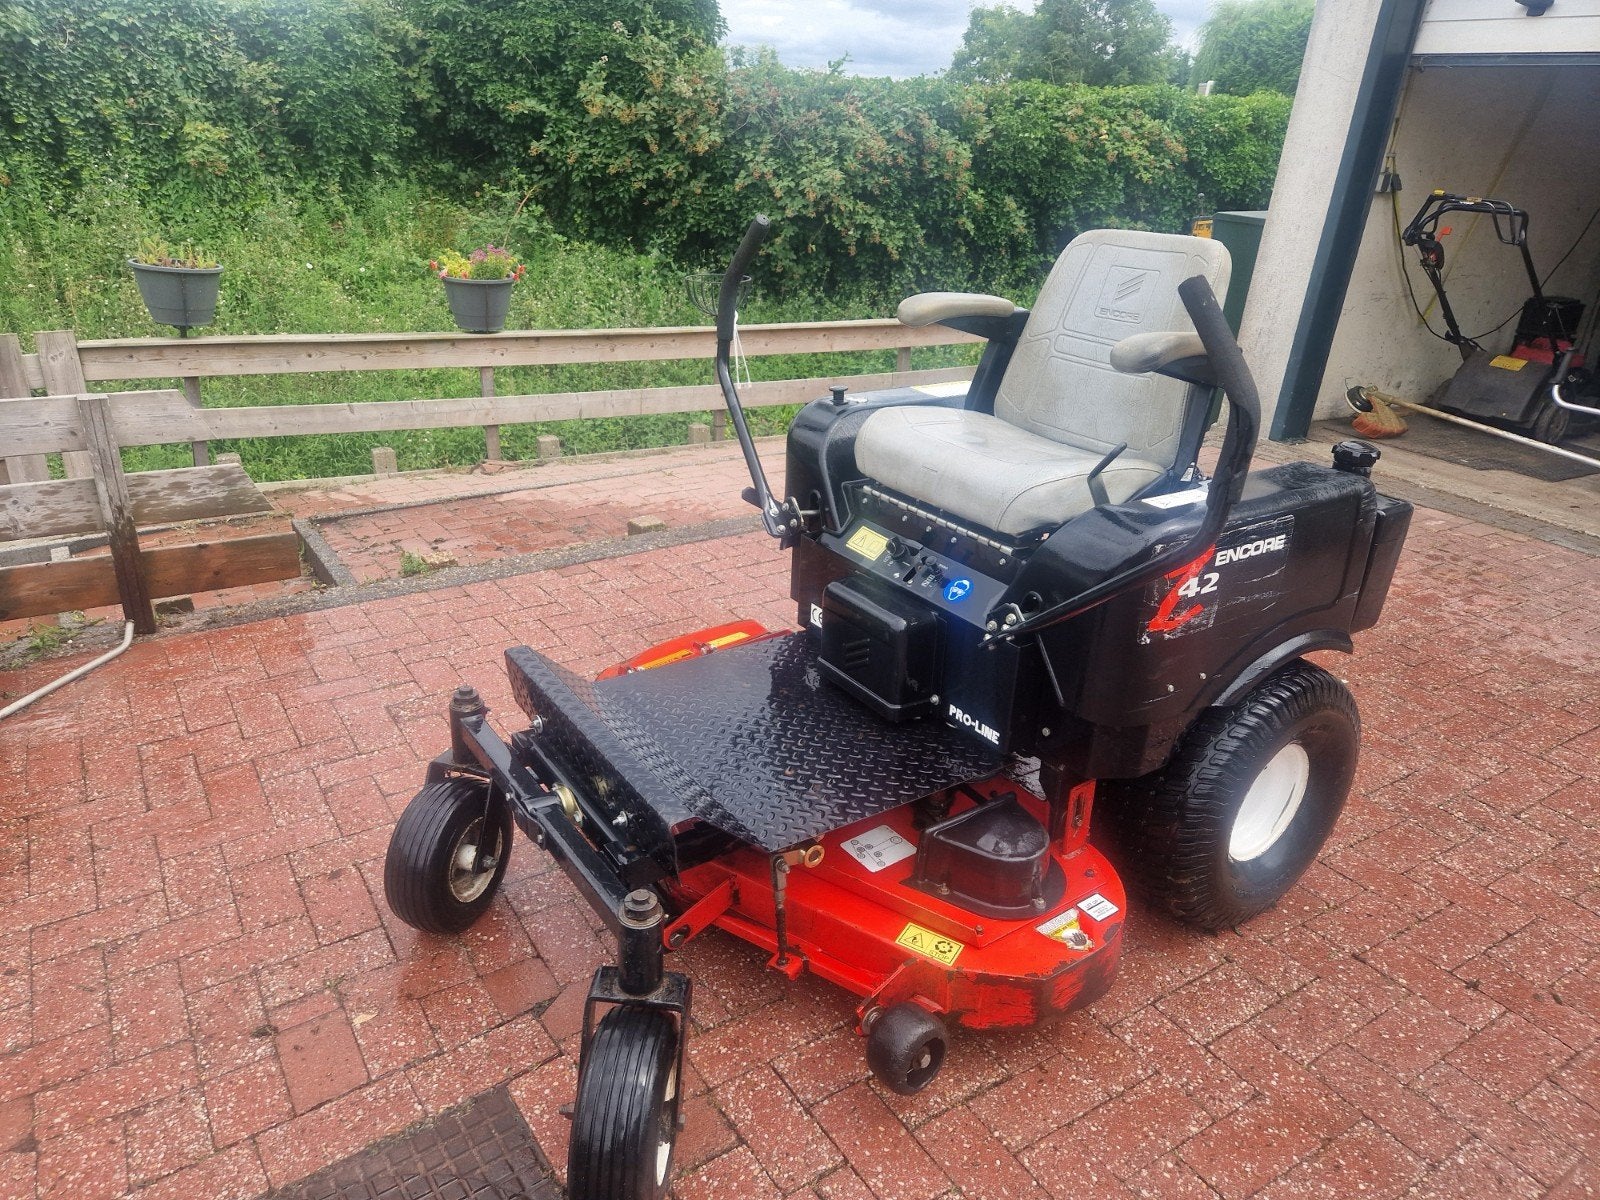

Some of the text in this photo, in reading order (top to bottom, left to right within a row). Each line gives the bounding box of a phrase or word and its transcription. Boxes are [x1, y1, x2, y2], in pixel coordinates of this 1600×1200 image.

[1099, 306, 1140, 321] ENCORE
[1214, 534, 1287, 567] ENCORE
[1177, 572, 1220, 598] 42
[948, 703, 1001, 745] PRO-LINE
[928, 950, 950, 960] STOP
